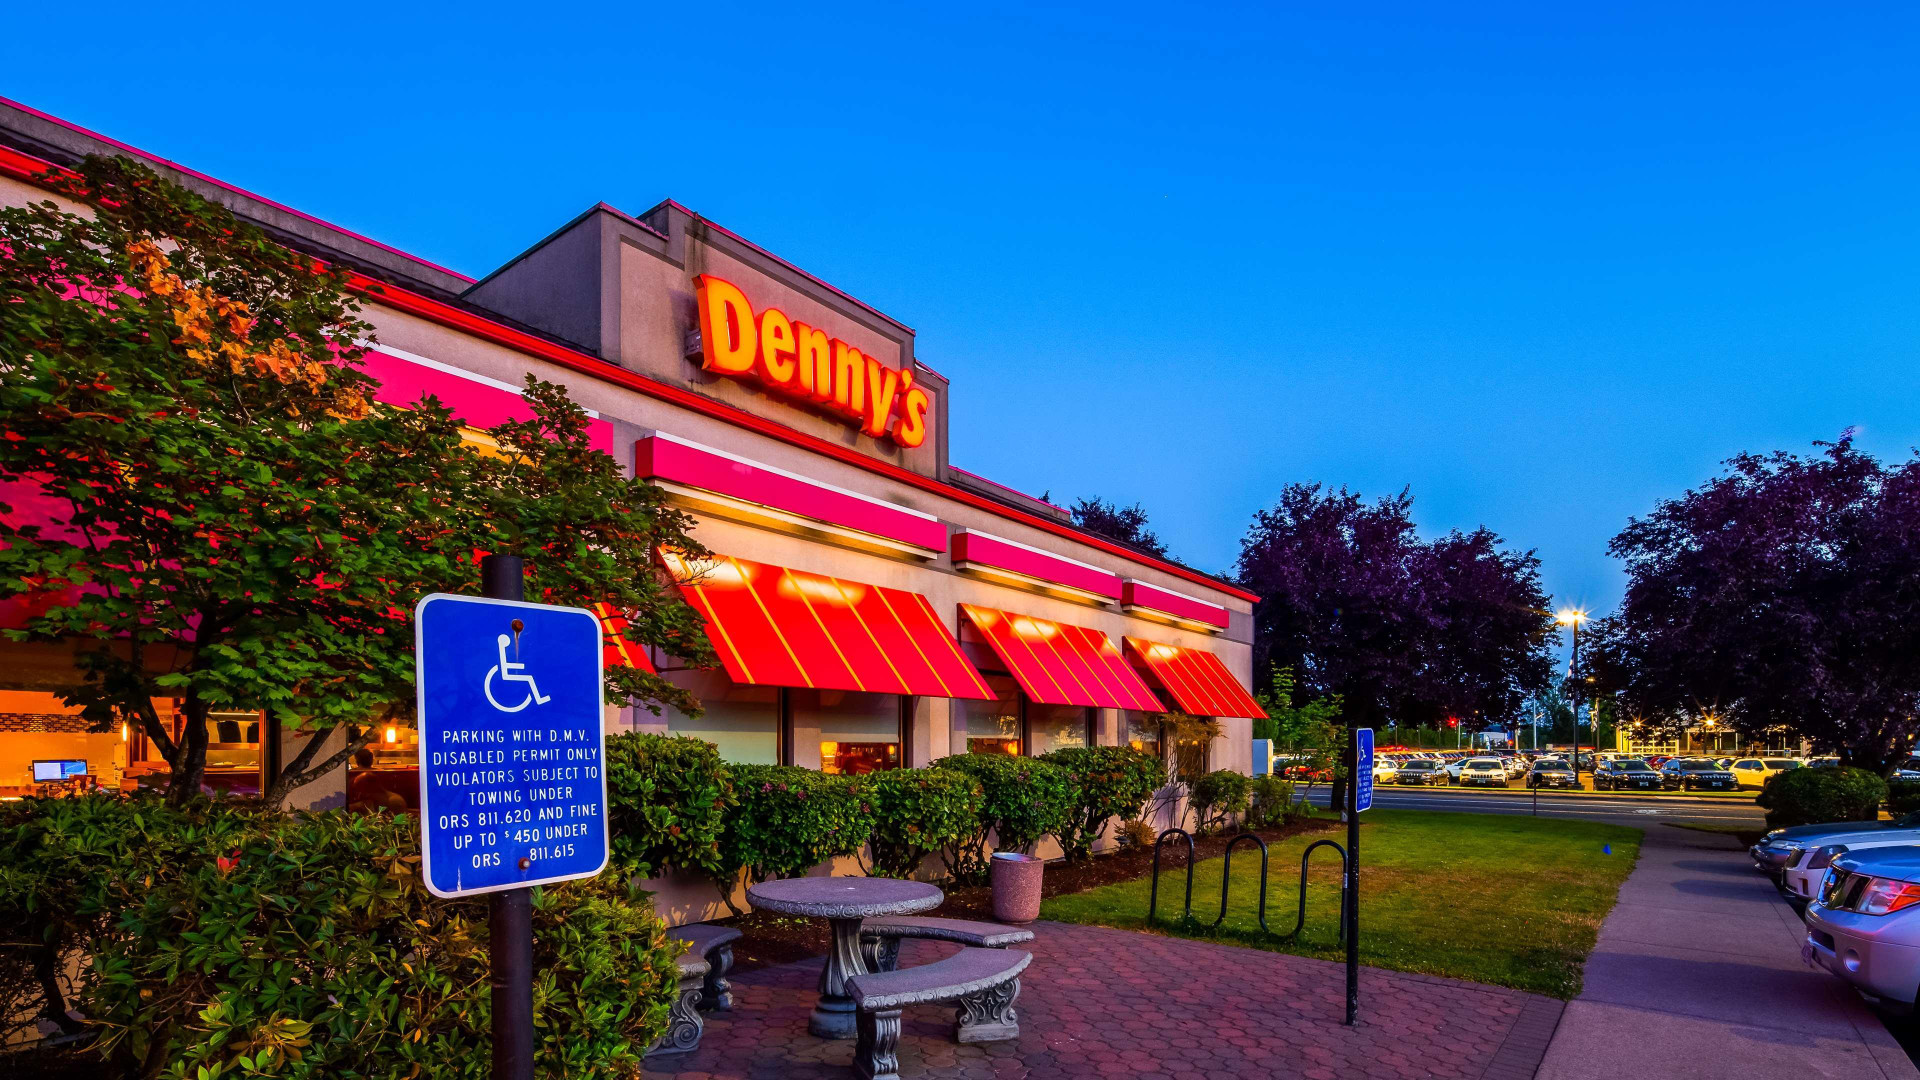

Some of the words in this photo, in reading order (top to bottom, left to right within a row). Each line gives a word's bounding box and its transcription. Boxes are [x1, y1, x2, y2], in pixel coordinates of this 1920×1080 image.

[698, 274, 929, 448] Denny's
[443, 730, 504, 743] PARKING
[513, 730, 542, 742] WITH
[550, 730, 589, 742] D.M.V.
[433, 751, 504, 766] DISABLED
[513, 749, 560, 762] PERMIT
[567, 748, 597, 761] ONLY
[436, 770, 514, 786] VIOLATORS
[524, 768, 578, 782] SUBJECT
[585, 767, 598, 779] TO
[469, 790, 521, 805] TOWING
[529, 787, 573, 801] UNDER
[440, 814, 469, 829] ORS
[478, 809, 531, 826] 811.620
[539, 807, 563, 820] AND
[570, 804, 597, 817] FINE
[454, 835, 472, 849] UP
[480, 832, 496, 847] TO
[545, 824, 587, 839] UNDER
[473, 853, 500, 868] ORS
[530, 844, 574, 861] 811.615
